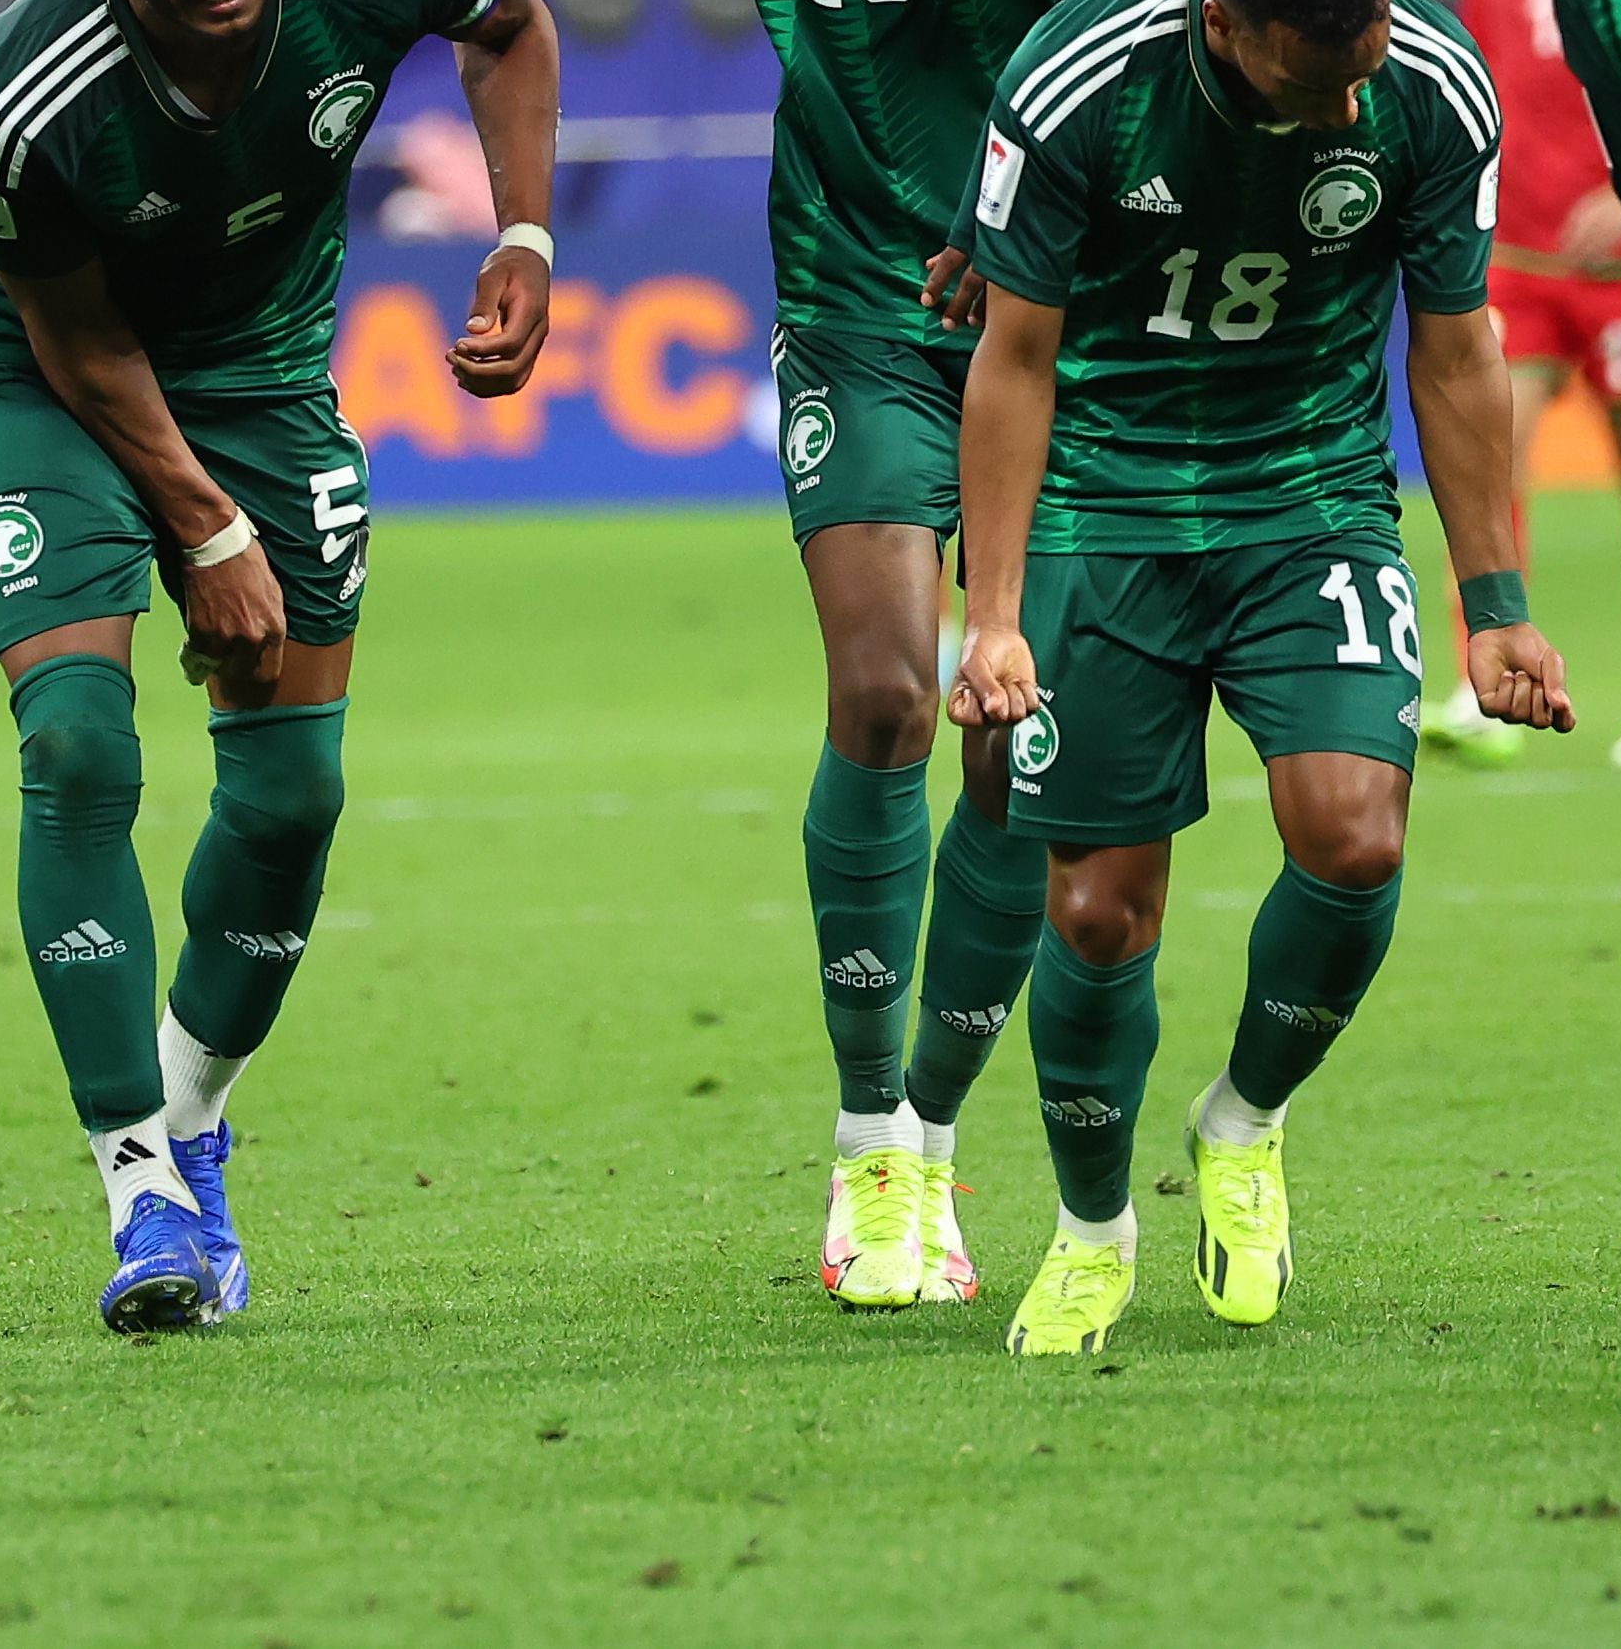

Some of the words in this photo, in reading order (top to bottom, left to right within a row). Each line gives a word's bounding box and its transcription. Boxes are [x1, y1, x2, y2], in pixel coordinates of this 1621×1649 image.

[306, 64, 364, 100] السعودية
[1313, 147, 1379, 165] السعودية
[124, 200, 181, 224] adidas
[1120, 198, 1183, 214] adidas
[1311, 241, 1351, 257] SAUDI
[1146, 247, 1291, 341] 18
[795, 474, 820, 494] SAUDI
[309, 465, 368, 563] 5
[2, 575, 39, 597] SAUDI
[1319, 561, 1422, 681] 18
[1011, 777, 1041, 795] SAUDI
[39, 939, 127, 962] adidas
[224, 929, 302, 962] adida
[824, 966, 897, 988] adidas
